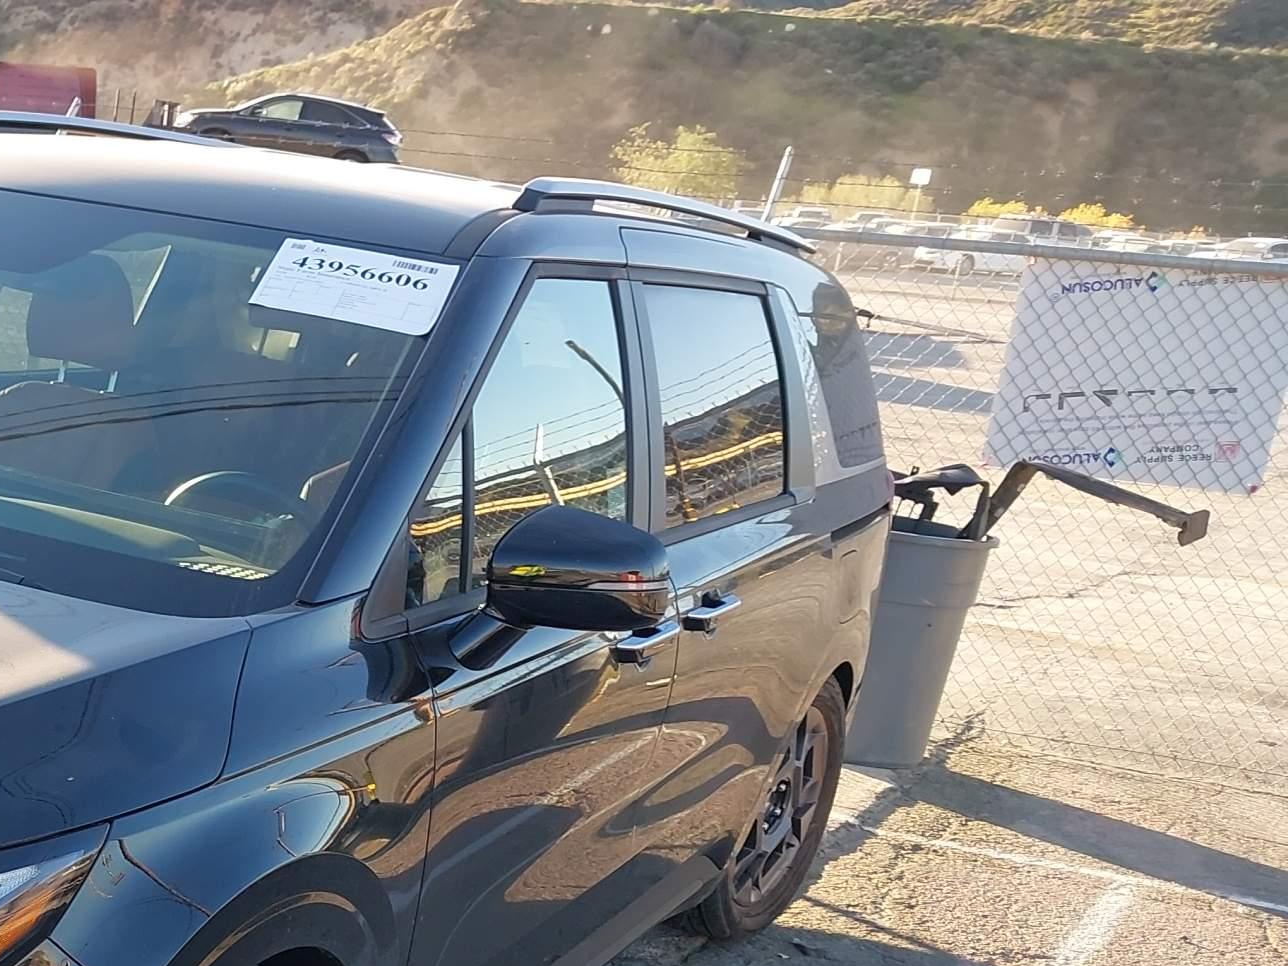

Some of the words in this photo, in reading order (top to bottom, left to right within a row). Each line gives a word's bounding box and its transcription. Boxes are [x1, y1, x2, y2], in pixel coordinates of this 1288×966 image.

[291, 256, 431, 291] 43956606
[1062, 277, 1144, 295] ALUCOSUN
[1149, 444, 1200, 453] COMPANY
[1135, 454, 1174, 464] SUPPLY
[1177, 453, 1212, 462] REECE
